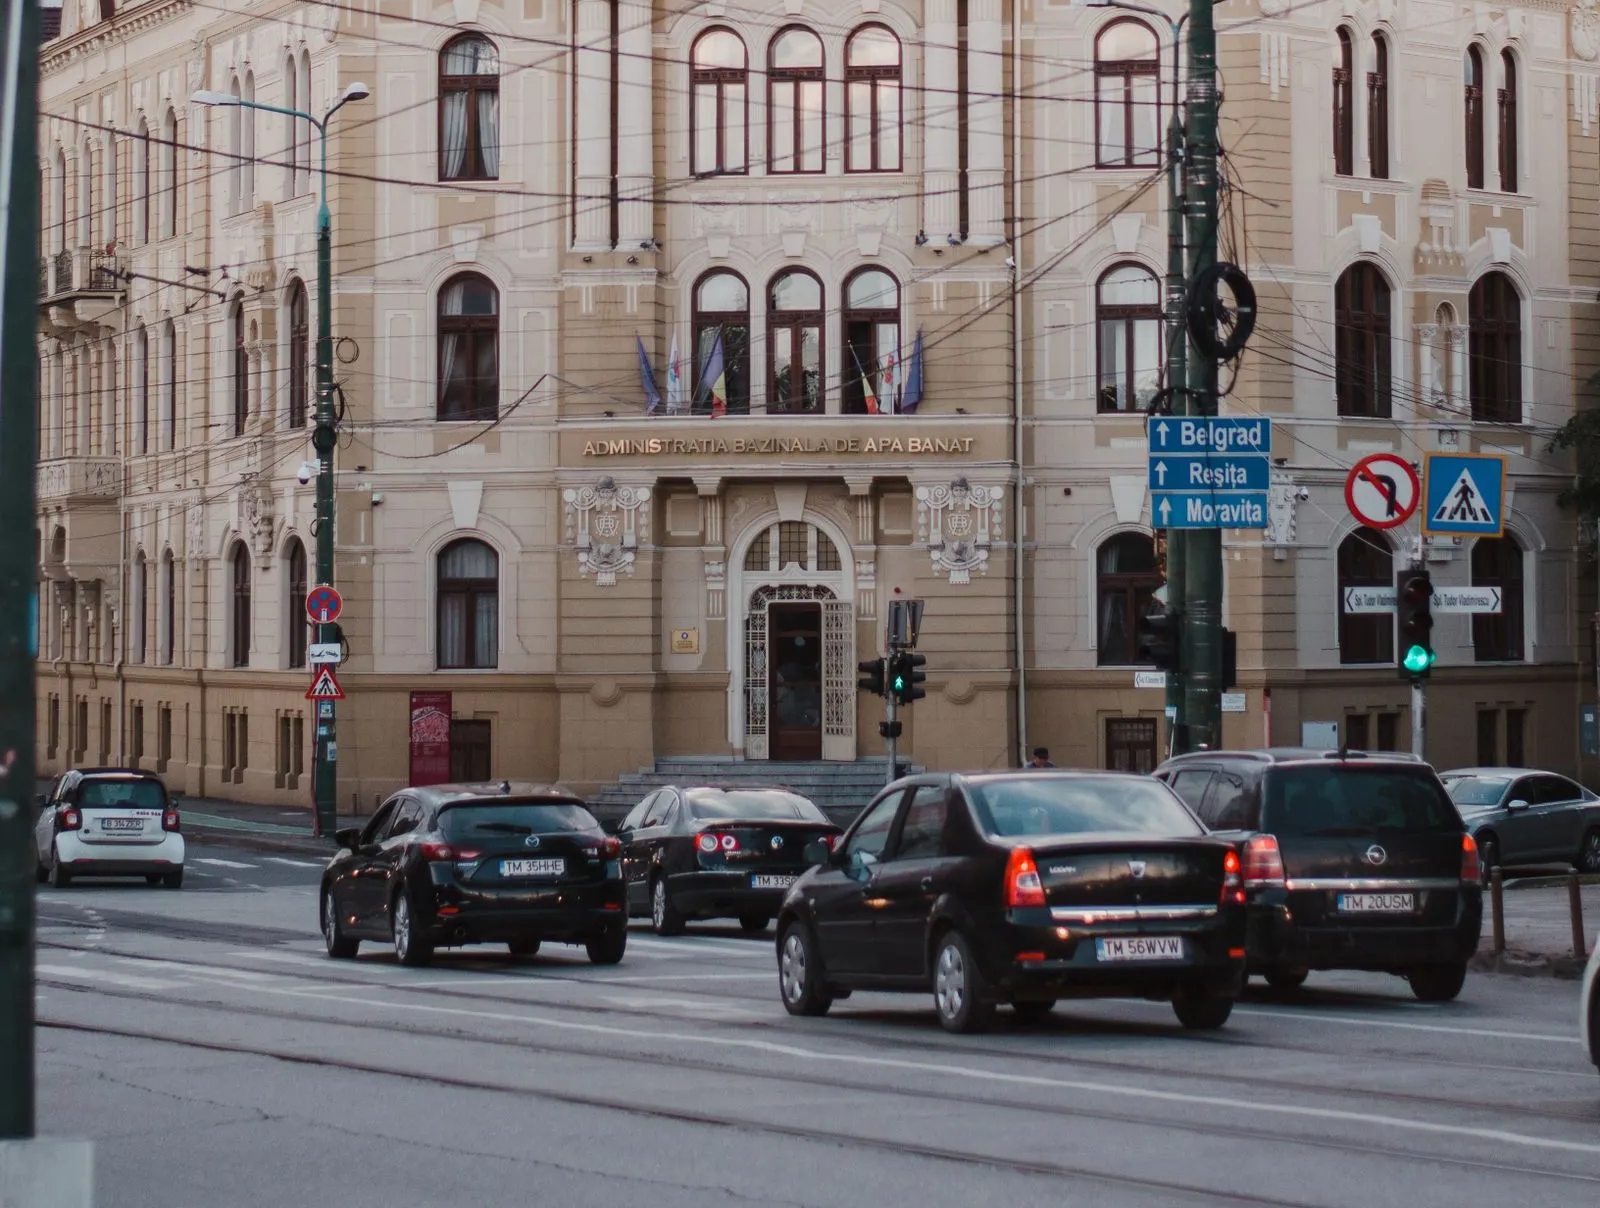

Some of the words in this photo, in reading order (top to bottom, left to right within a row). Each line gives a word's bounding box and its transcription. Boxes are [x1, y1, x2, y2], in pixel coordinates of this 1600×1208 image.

[1180, 420, 1262, 452] Belgrad
[583, 438, 728, 456] ADMINISTRATIA
[732, 438, 829, 454] BAZINALA
[835, 438, 860, 453] DE
[864, 437, 904, 453] APA
[908, 437, 974, 453] BANAT
[505, 860, 523, 873] TM
[526, 859, 562, 873] 35HHE
[757, 875, 771, 887] TM
[1344, 895, 1364, 909] TM
[1367, 895, 1413, 909] 20USM
[1105, 941, 1124, 956] TM
[1128, 939, 1180, 954] 56WVW
